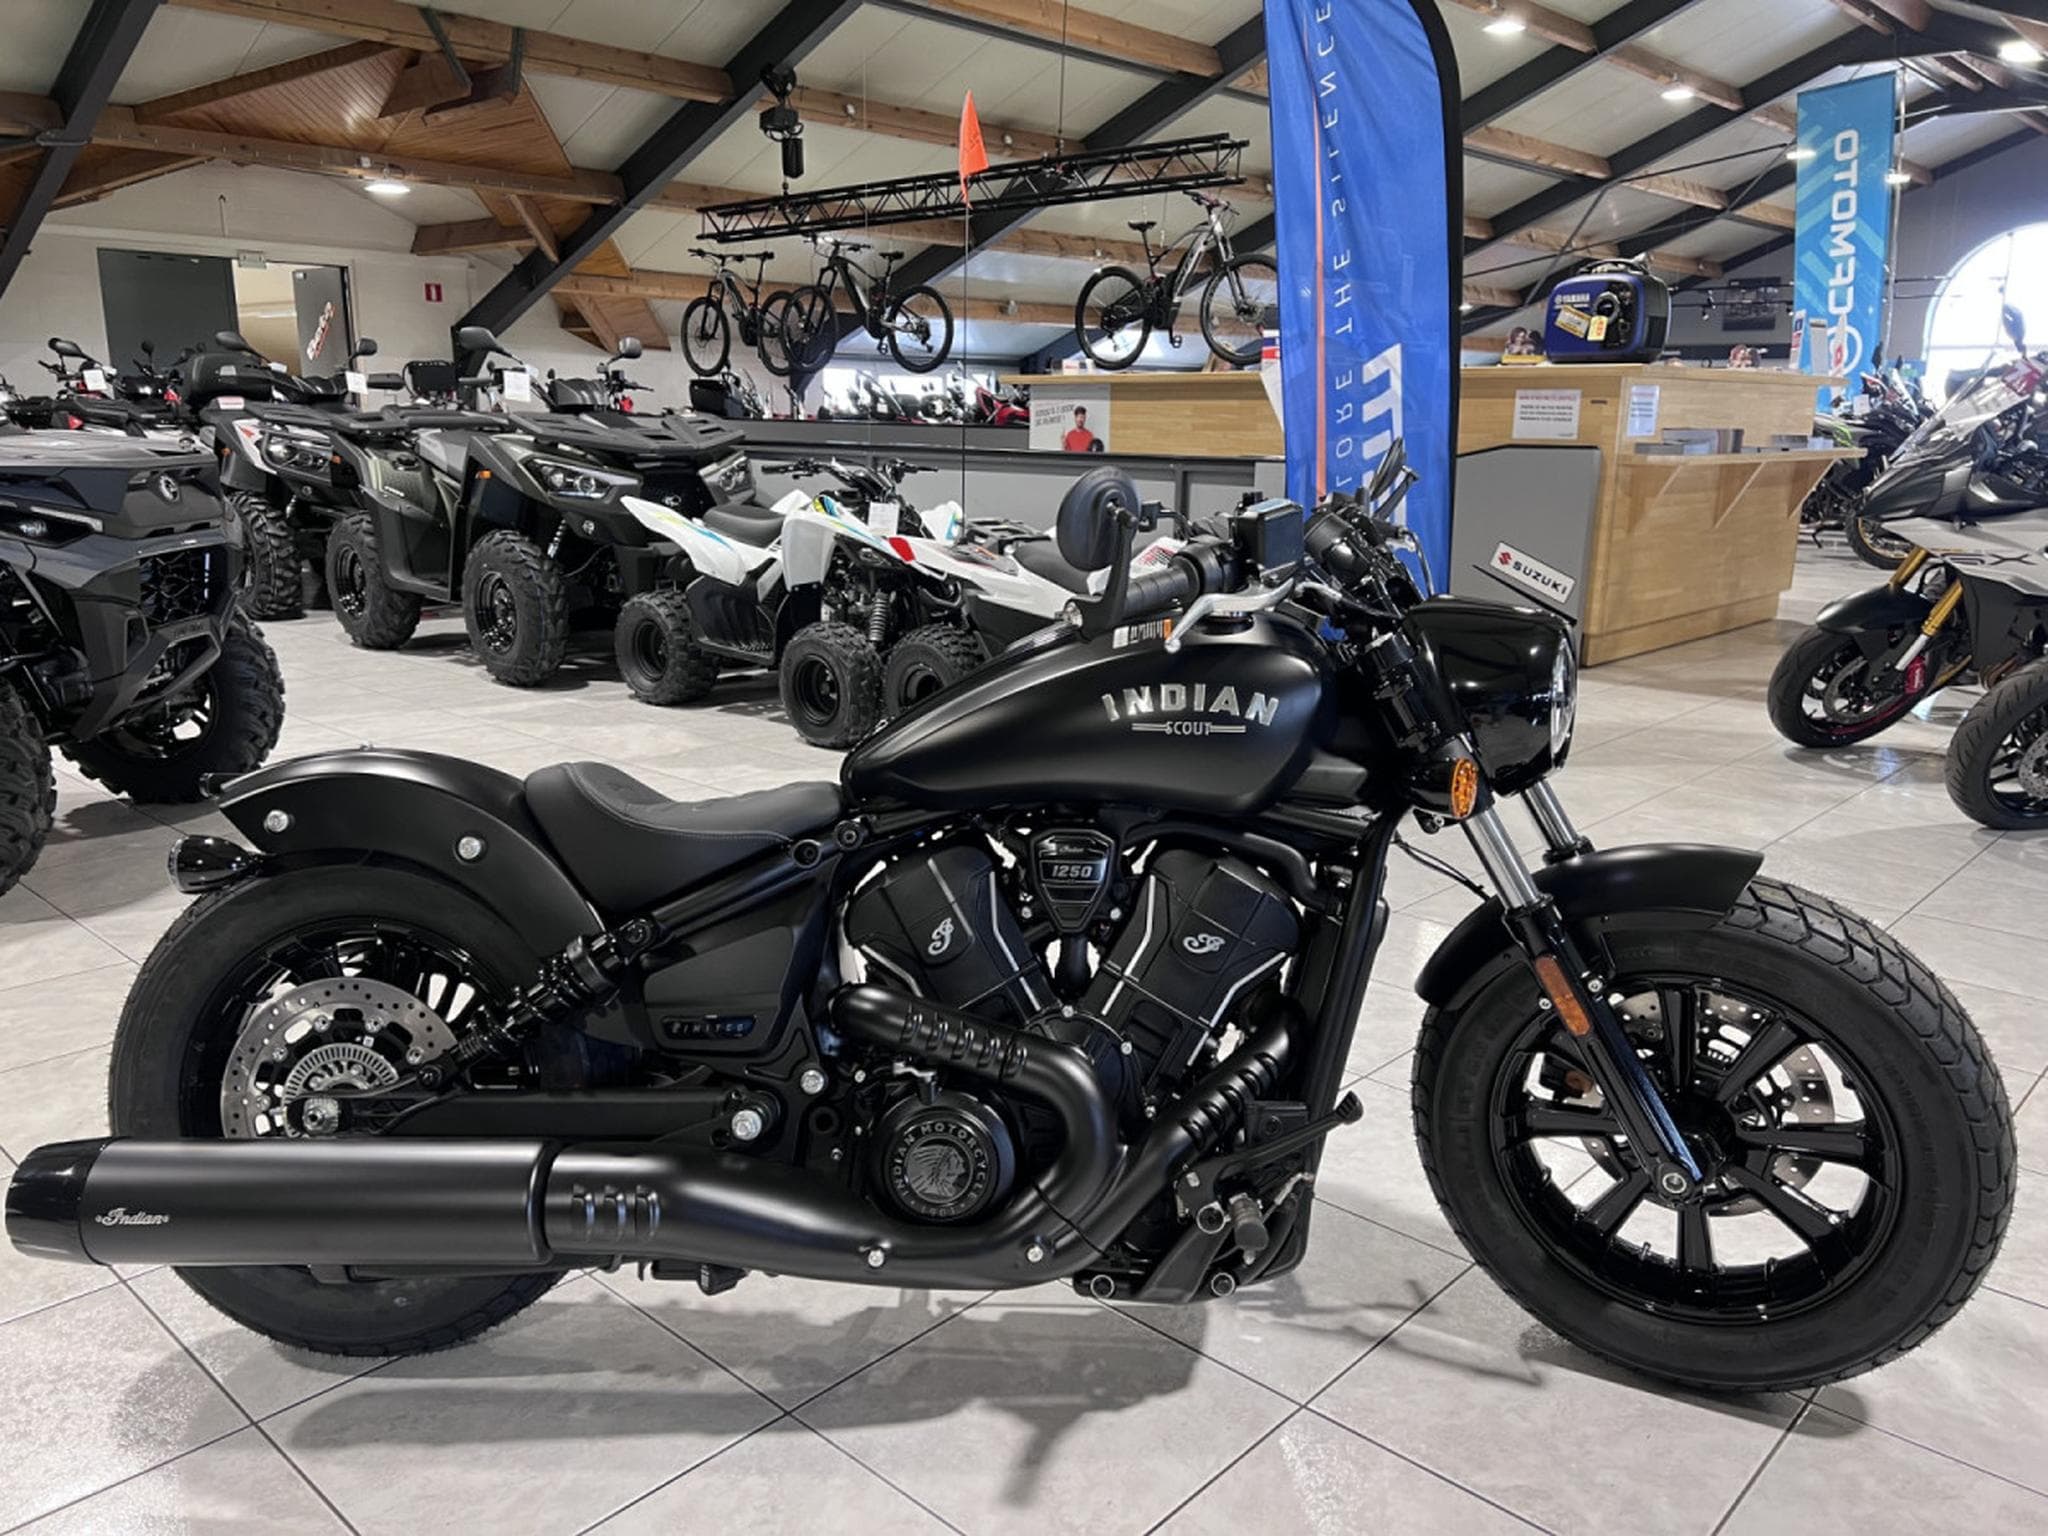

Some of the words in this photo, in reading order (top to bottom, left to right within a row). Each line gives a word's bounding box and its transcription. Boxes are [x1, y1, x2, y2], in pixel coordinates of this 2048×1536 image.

[1512, 561, 1567, 594] SUZUKI
[1102, 683, 1280, 726] INDIAN
[1165, 721, 1212, 735] SCOUT
[1051, 865, 1093, 878] 1250
[892, 1134, 916, 1198] INDIAN
[920, 1122, 987, 1200] MOTORCYCLE
[102, 1208, 162, 1226] Indian
